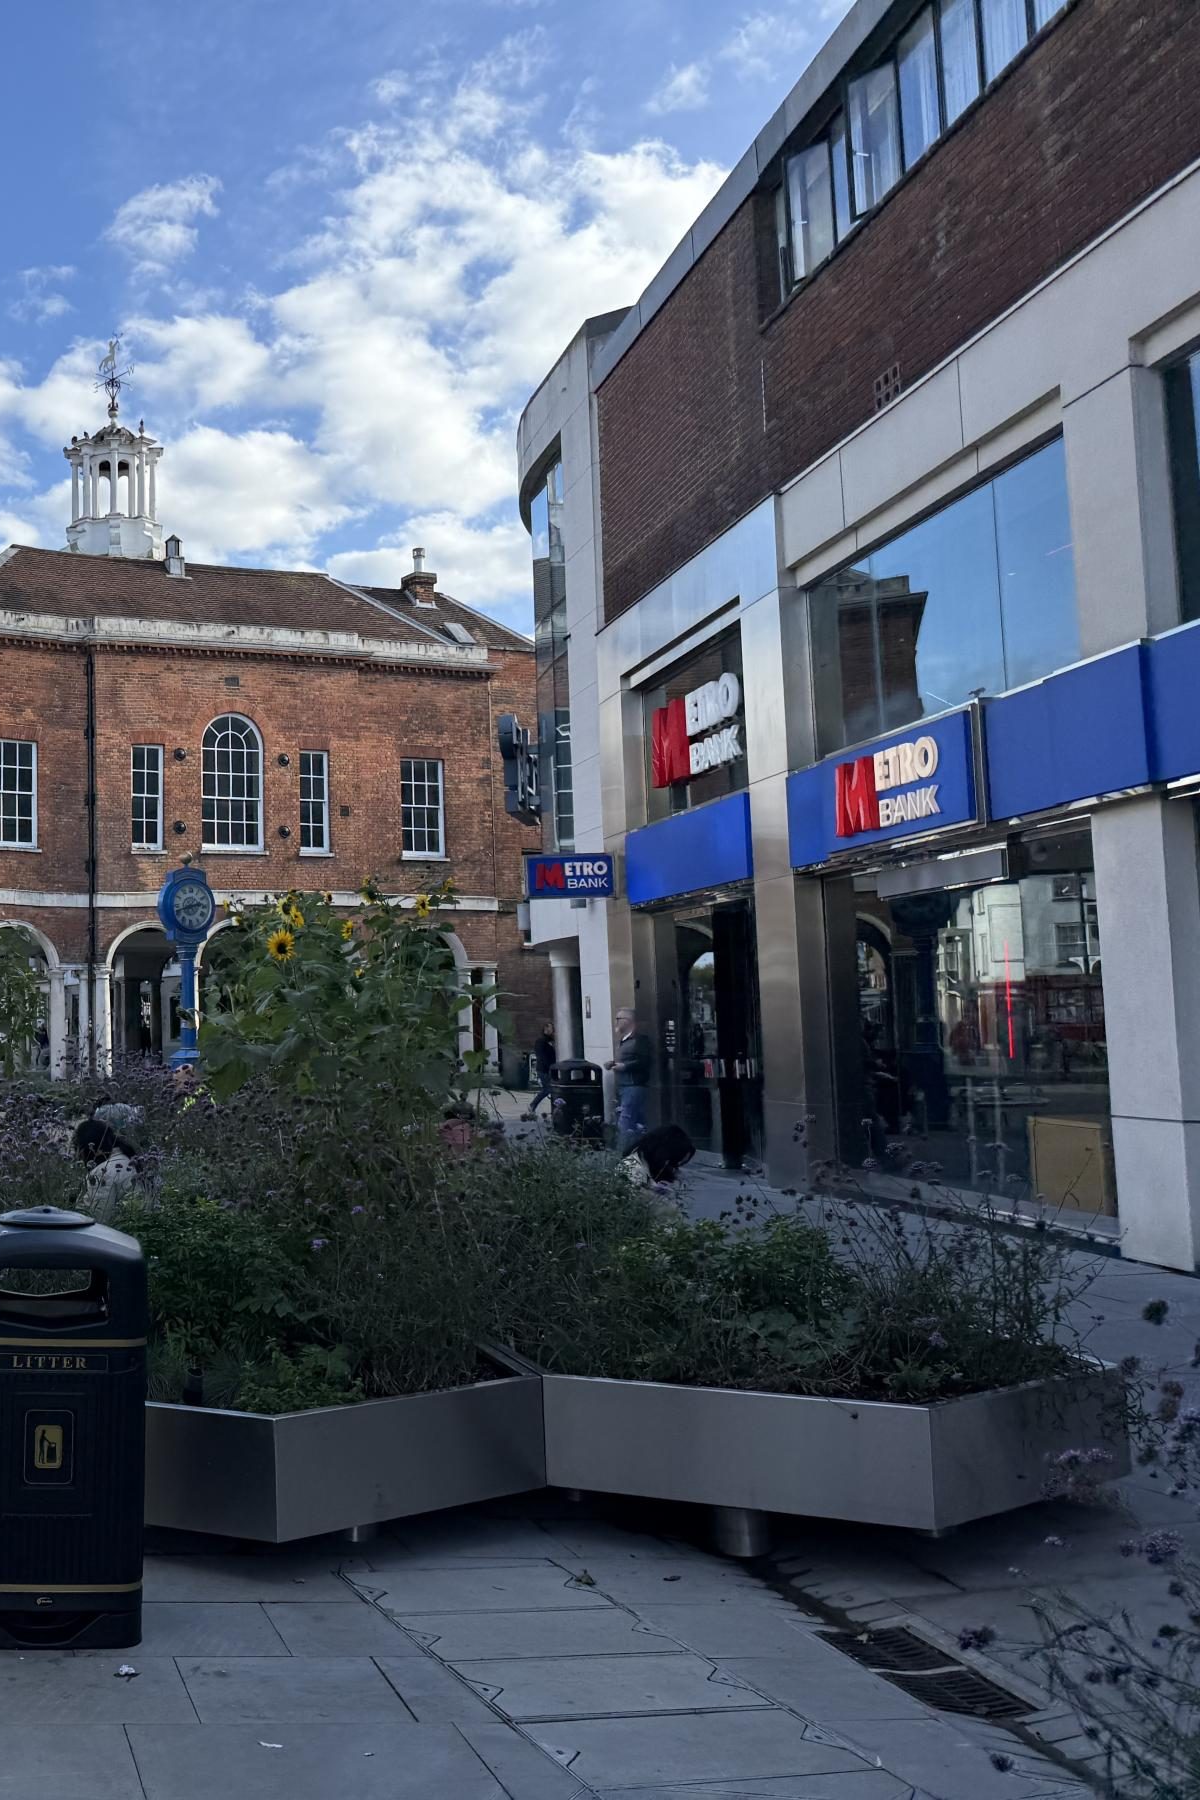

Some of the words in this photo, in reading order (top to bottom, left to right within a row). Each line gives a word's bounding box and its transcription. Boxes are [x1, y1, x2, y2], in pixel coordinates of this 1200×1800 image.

[651, 672, 740, 788] METRO
[689, 724, 743, 775] BANK
[835, 736, 939, 837] METRO
[878, 784, 941, 828] BANK
[536, 861, 608, 890] METRO
[567, 878, 609, 889] BANK
[12, 1355, 87, 1369] LITTER
